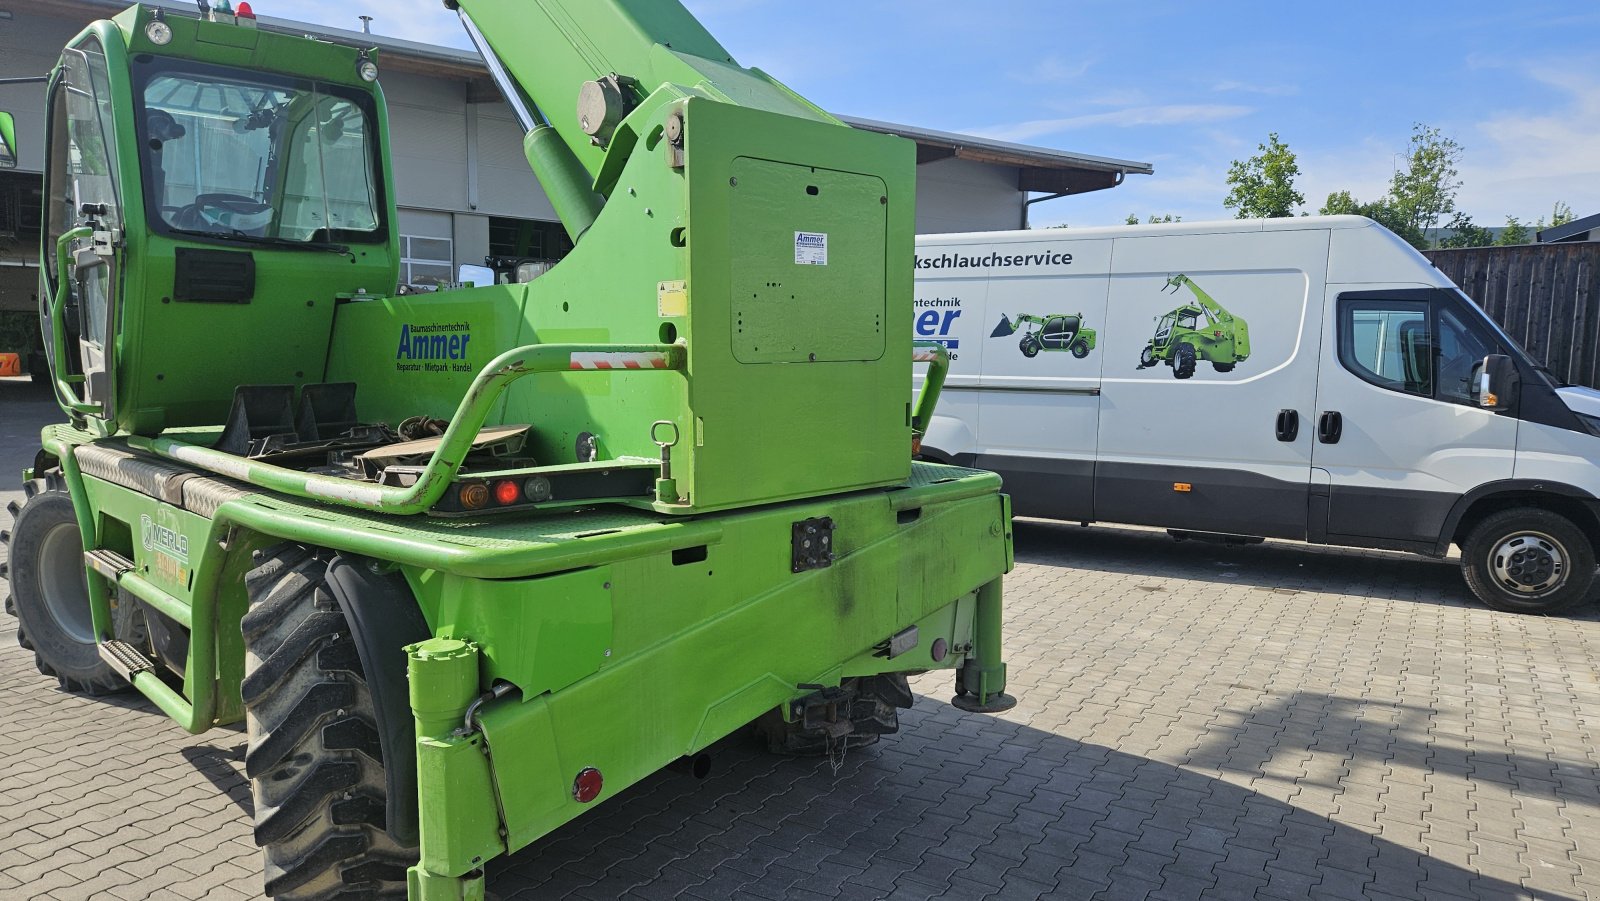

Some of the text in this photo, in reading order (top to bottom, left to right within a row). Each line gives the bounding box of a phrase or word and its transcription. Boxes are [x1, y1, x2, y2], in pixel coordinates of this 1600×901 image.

[797, 233, 824, 243] Ammer
[914, 250, 1073, 269] kschlauchservice
[410, 321, 470, 333] Baumaschinentechnik
[913, 310, 962, 336] er
[396, 323, 470, 360] Ammer
[396, 362, 472, 373] Reparatur Mietpark Handel
[153, 524, 189, 556] MERLO
